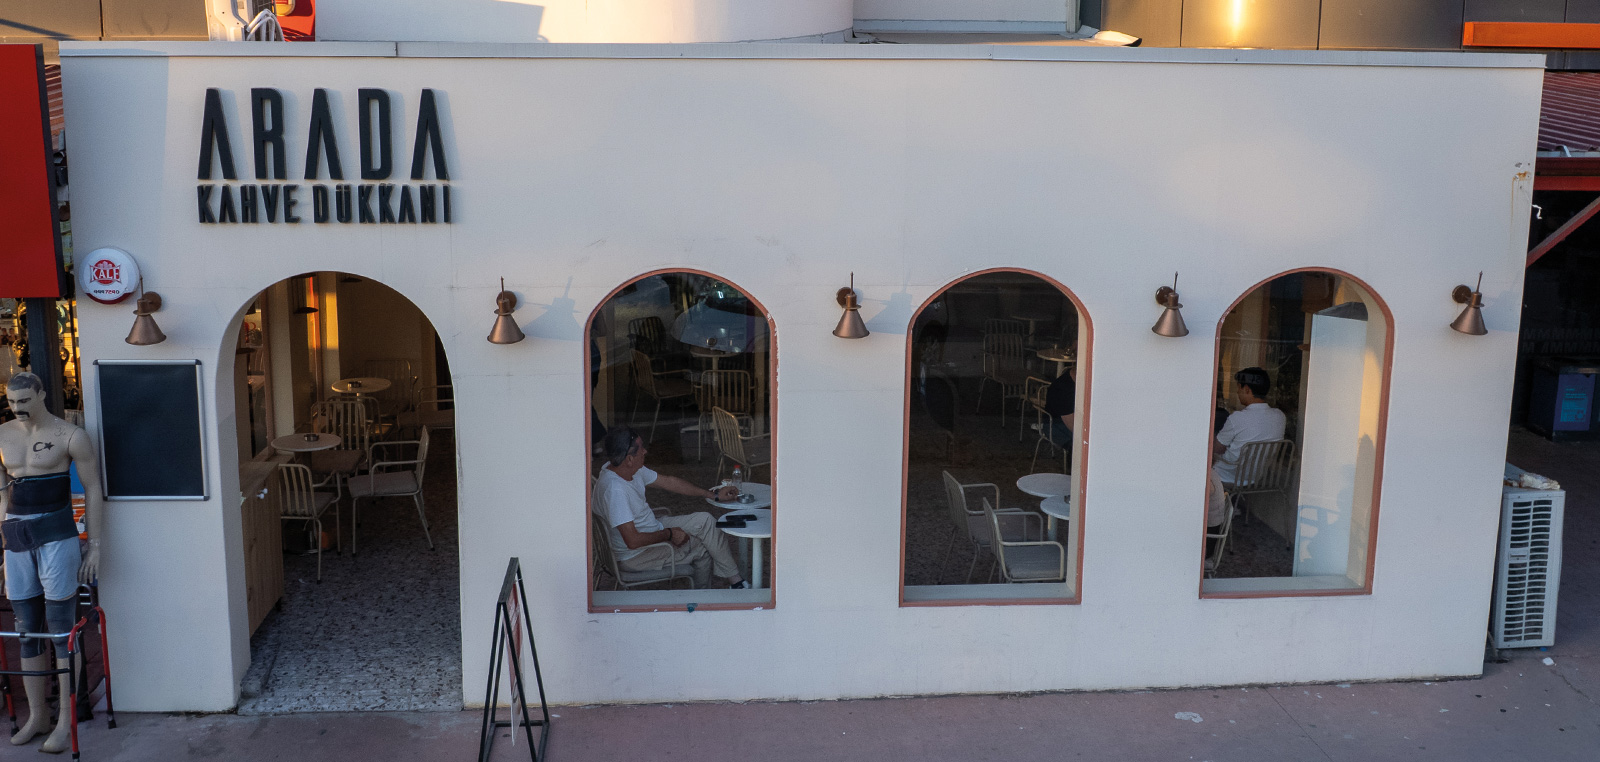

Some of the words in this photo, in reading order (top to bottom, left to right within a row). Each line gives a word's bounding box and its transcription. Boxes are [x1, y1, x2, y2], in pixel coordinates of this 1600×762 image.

[197, 87, 450, 181] ARADA
[197, 184, 302, 224] KAHVE
[312, 183, 452, 224] DÜKKANI
[90, 265, 121, 282] KALE
